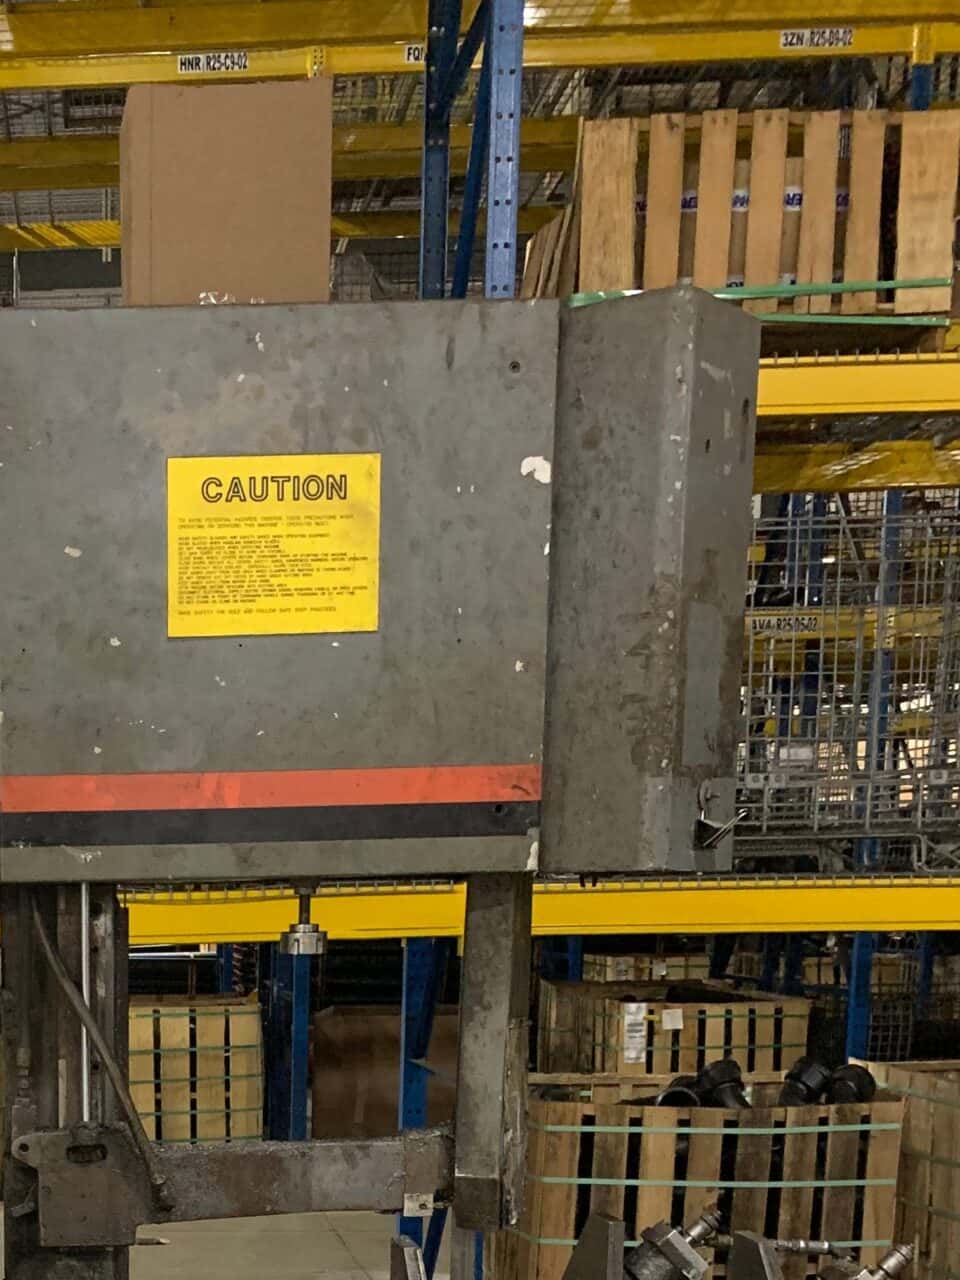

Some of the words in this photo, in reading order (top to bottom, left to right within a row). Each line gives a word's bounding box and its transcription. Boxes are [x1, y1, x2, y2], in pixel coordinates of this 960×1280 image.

[180, 56, 201, 72] HNR
[206, 52, 248, 71] R25-C9-02
[201, 474, 347, 503] CAUTION
